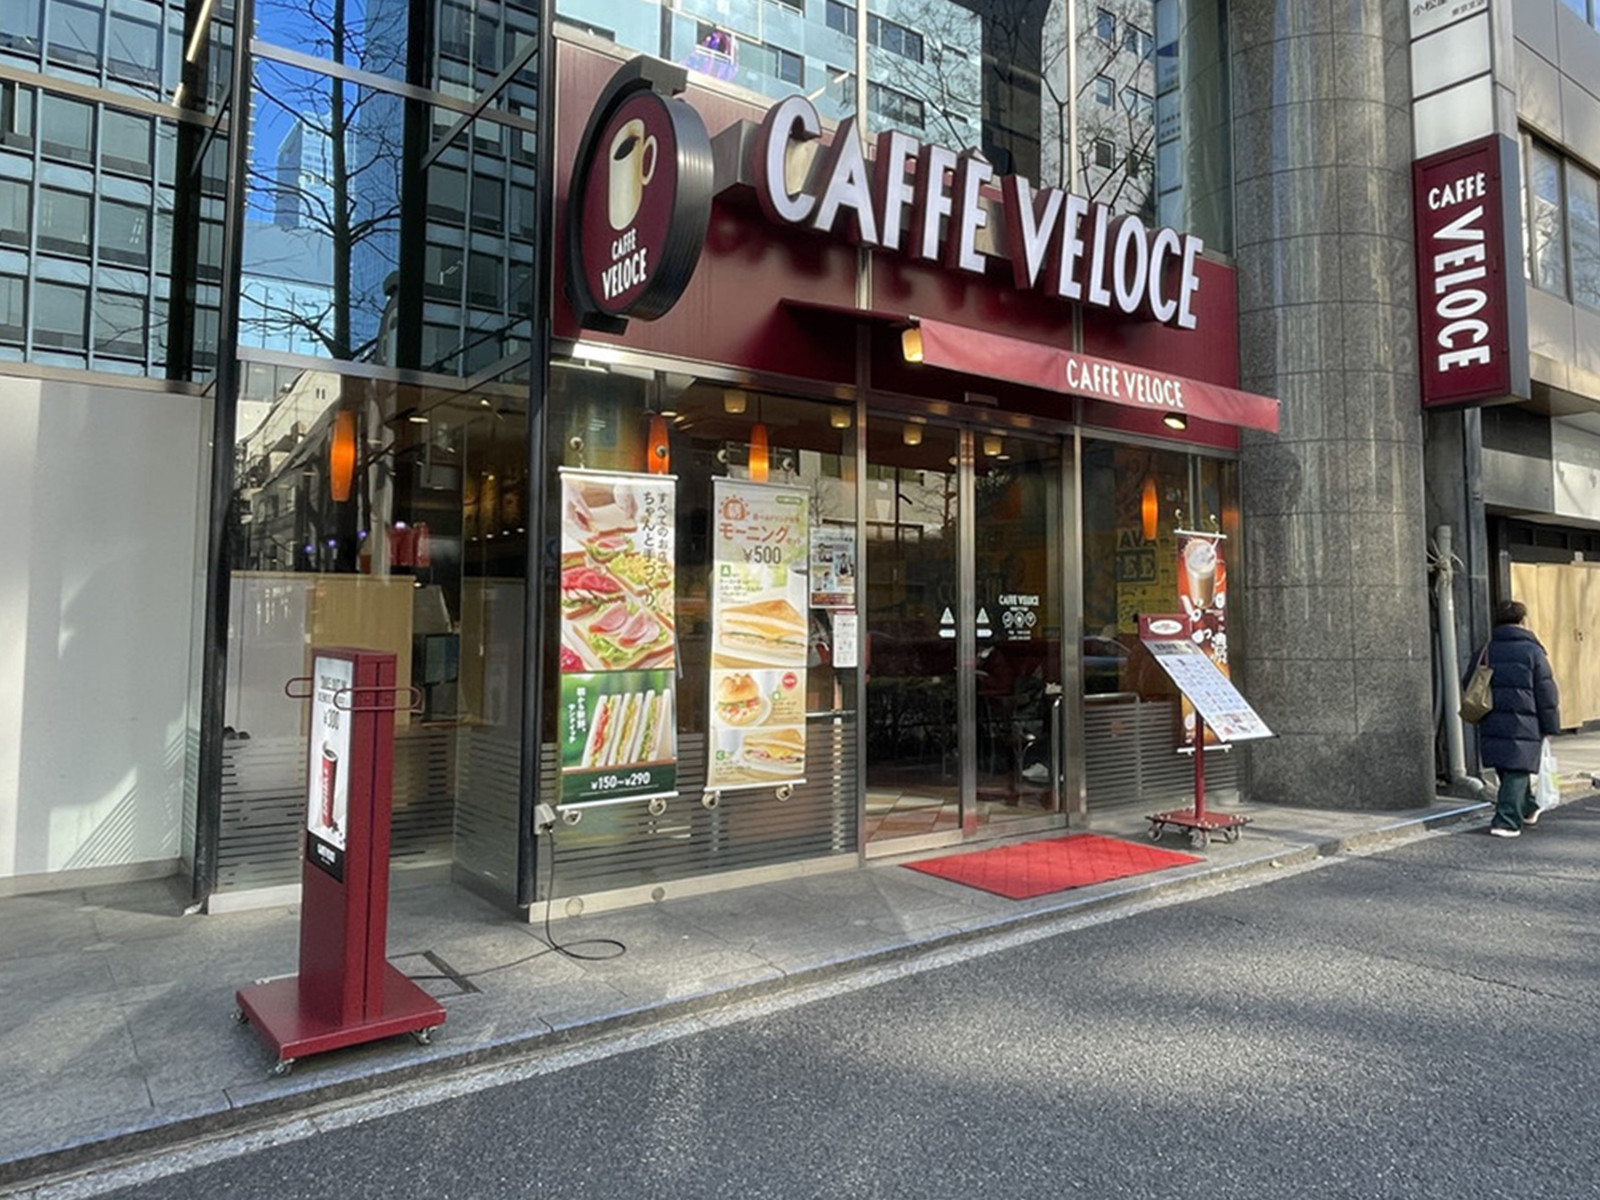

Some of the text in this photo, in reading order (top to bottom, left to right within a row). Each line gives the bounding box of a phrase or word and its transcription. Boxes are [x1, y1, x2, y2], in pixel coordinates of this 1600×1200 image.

[601, 246, 648, 301] VELOCE
[1015, 174, 1204, 330] VELOCE
[1432, 205, 1491, 372] VELOCE
[1122, 370, 1185, 408] VELOCE
[742, 545, 782, 565] ¥500
